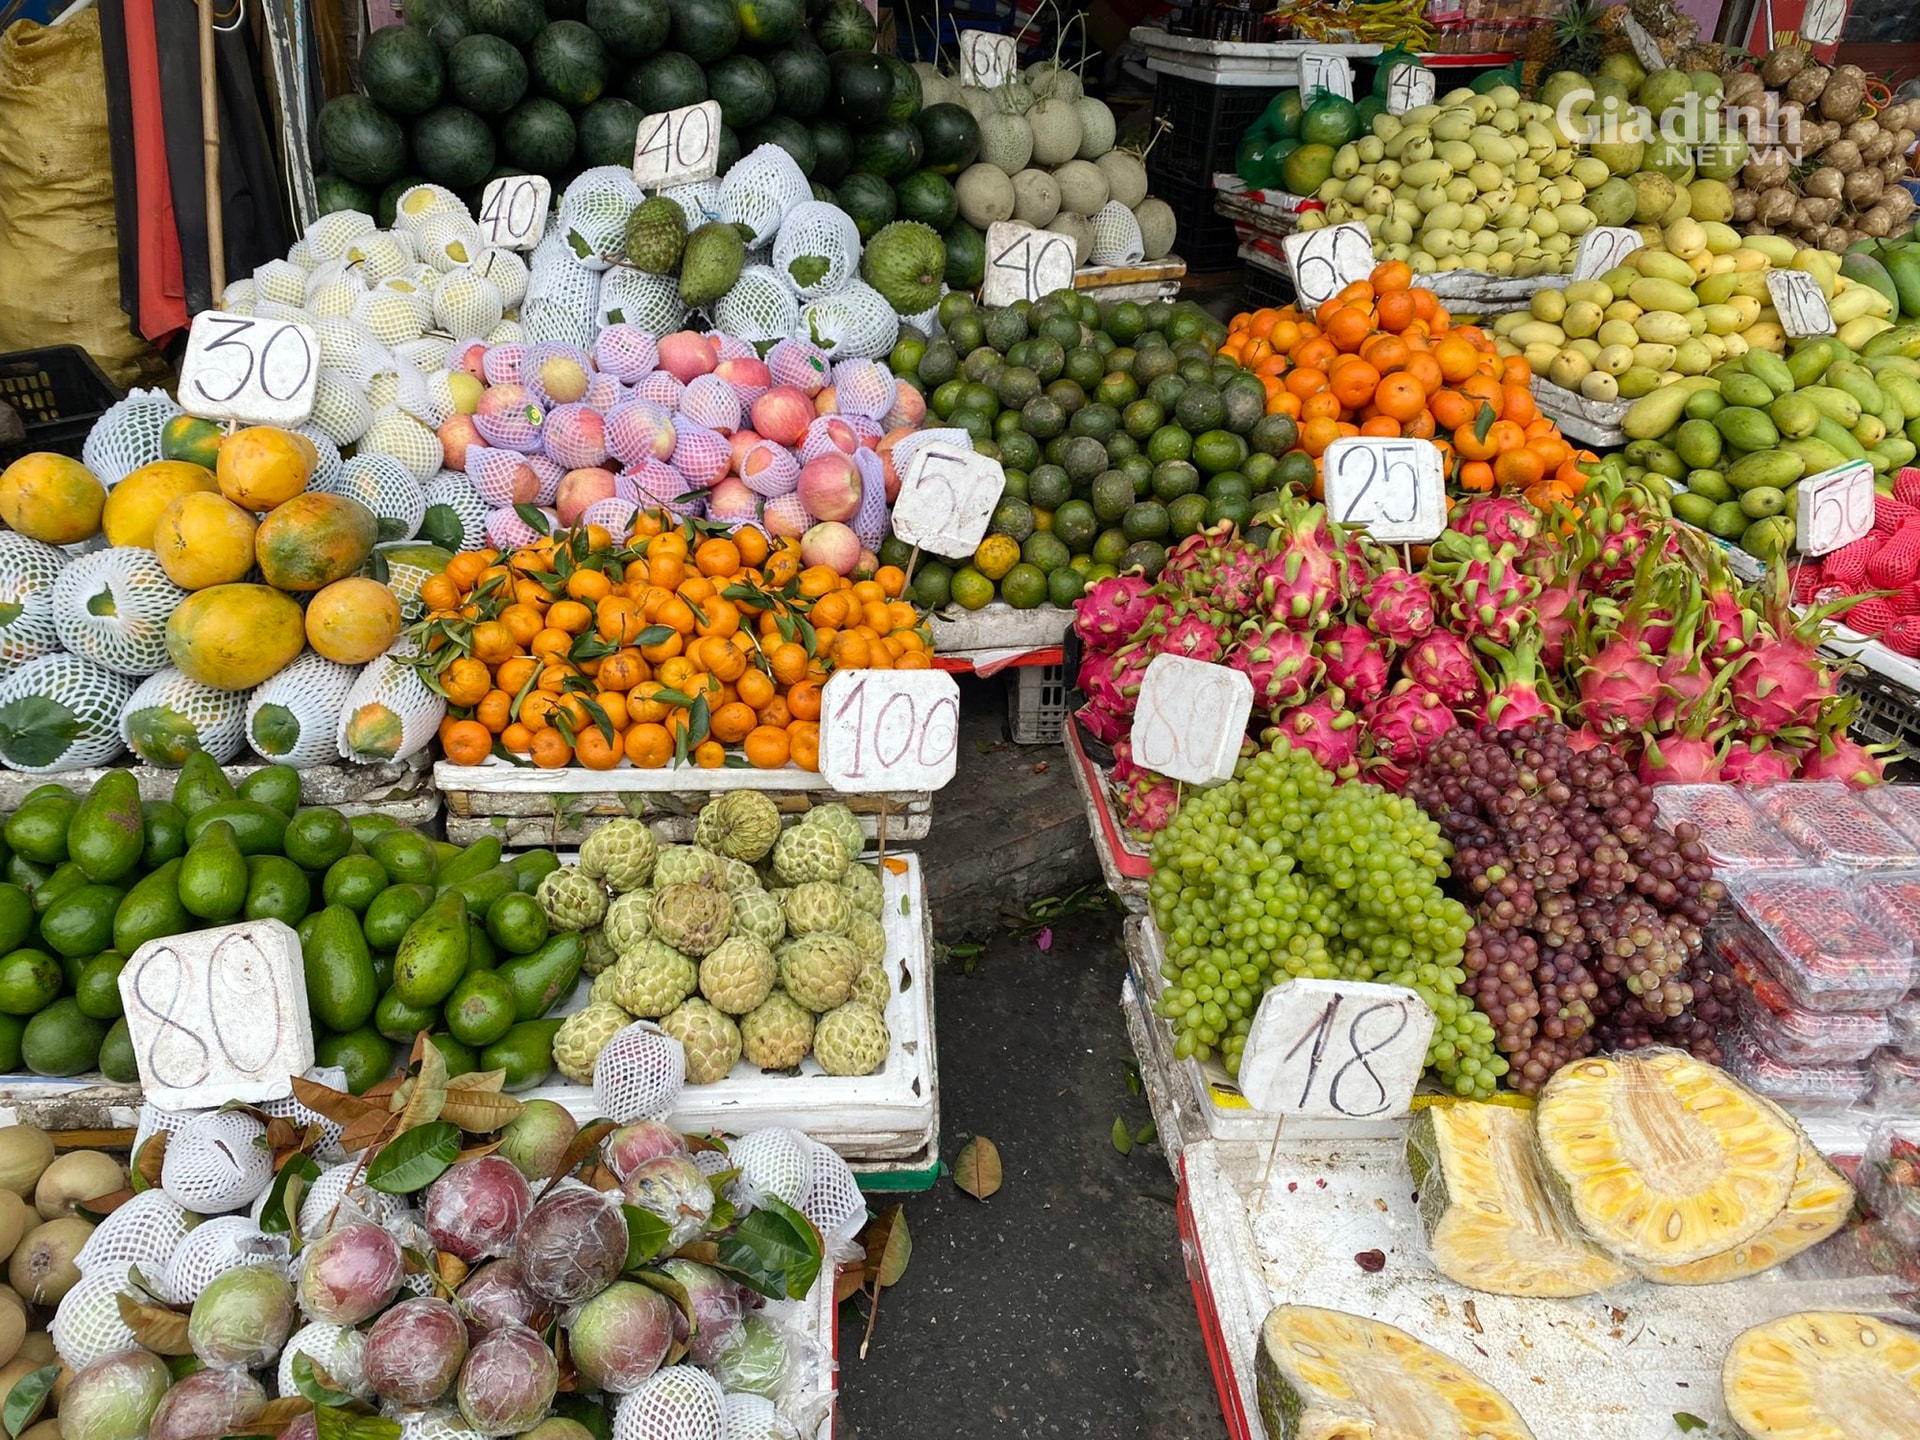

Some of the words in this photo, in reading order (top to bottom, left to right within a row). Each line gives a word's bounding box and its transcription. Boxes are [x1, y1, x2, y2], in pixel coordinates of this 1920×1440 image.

[1394, 65, 1434, 108] 45
[638, 106, 710, 173] 40
[482, 179, 538, 242] 40
[993, 232, 1076, 300] 40
[194, 317, 311, 402] 30
[1338, 445, 1418, 523] 25
[1813, 469, 1874, 551] 50
[833, 678, 959, 778] 100
[1142, 660, 1225, 769] 80
[133, 932, 281, 1089] 80
[1284, 993, 1408, 1117] 18
